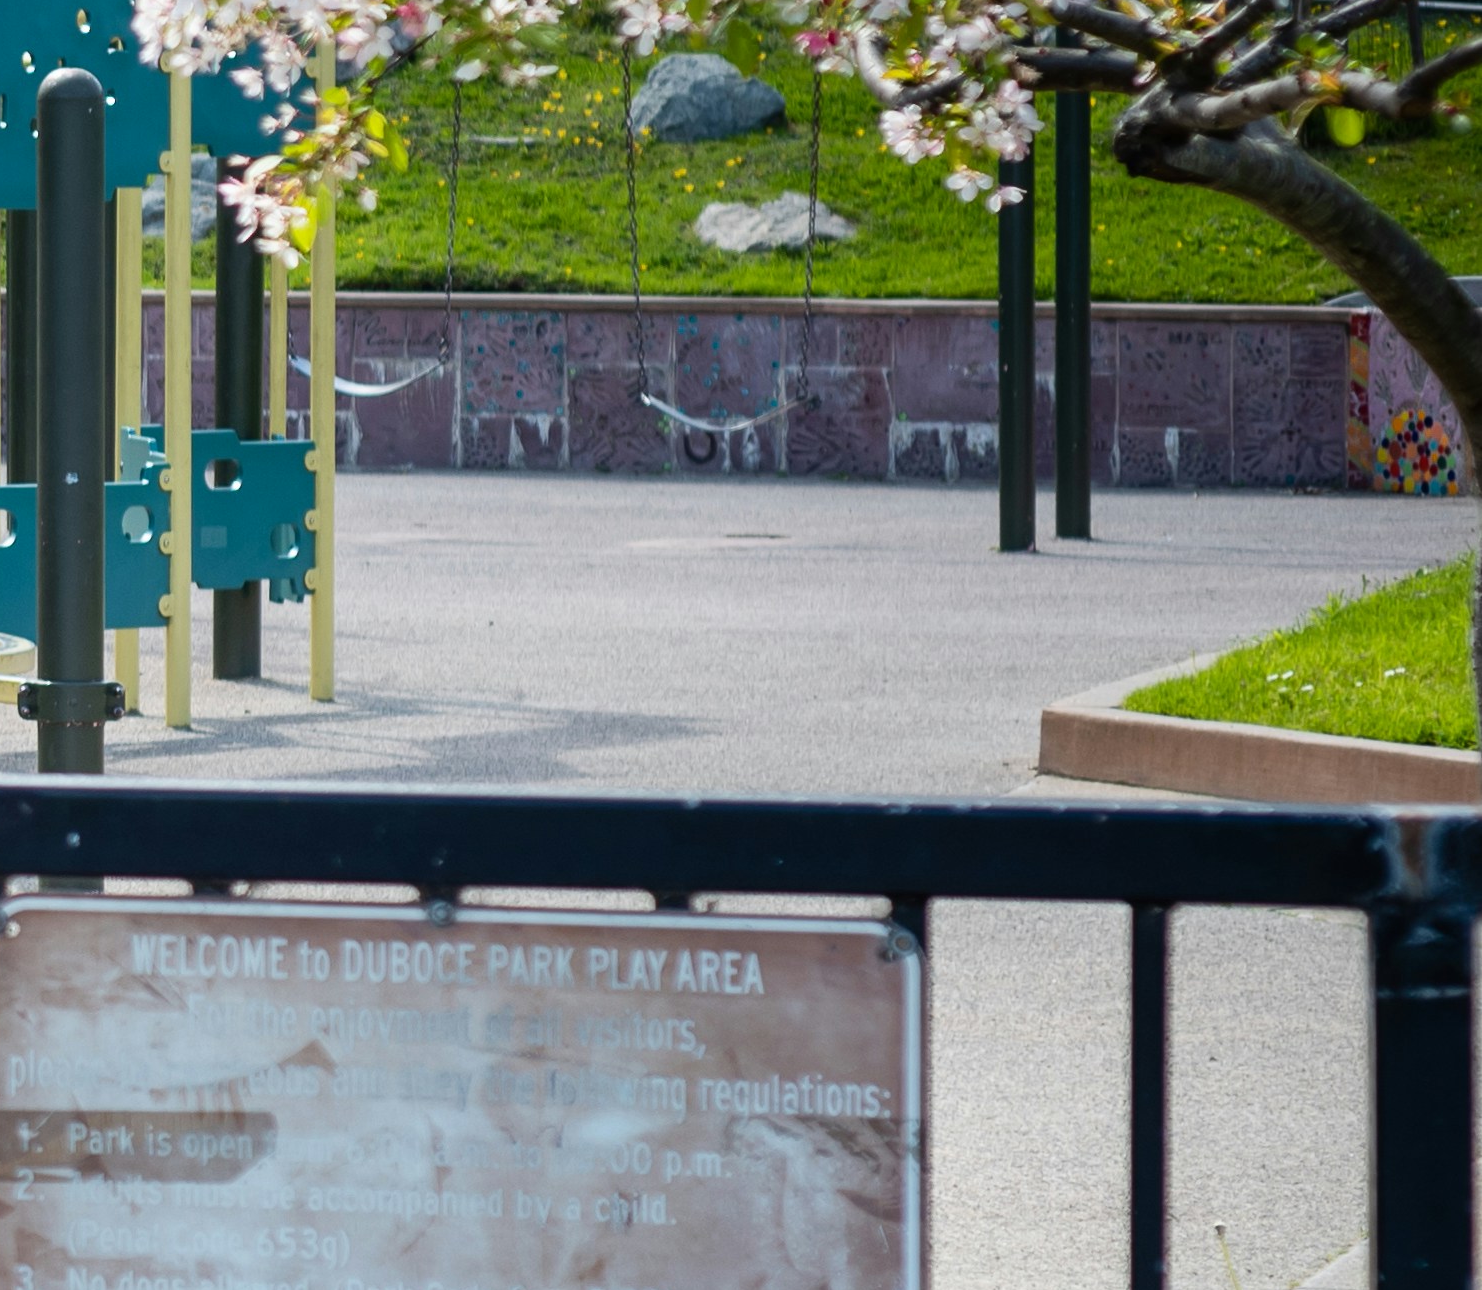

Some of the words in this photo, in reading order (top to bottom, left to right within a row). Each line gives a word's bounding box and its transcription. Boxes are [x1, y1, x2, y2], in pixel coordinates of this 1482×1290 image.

[130, 933, 289, 981] WELCOME
[299, 939, 332, 982] to
[341, 938, 477, 987] DUBOCE
[488, 944, 577, 989] PARK
[588, 947, 669, 993] PLAY
[674, 949, 766, 996] AREA
[573, 1009, 706, 1059] visitors,
[697, 1073, 891, 1123] regulations:
[68, 1121, 136, 1156] Park
[146, 1124, 173, 1157] is
[182, 1131, 254, 1168] open
[664, 1148, 732, 1184] p.m.
[15, 1167, 45, 1202] 2.
[513, 1190, 551, 1228] by
[562, 1196, 581, 1222] a
[593, 1192, 678, 1228] child.
[256, 1226, 352, 1270] 653g)
